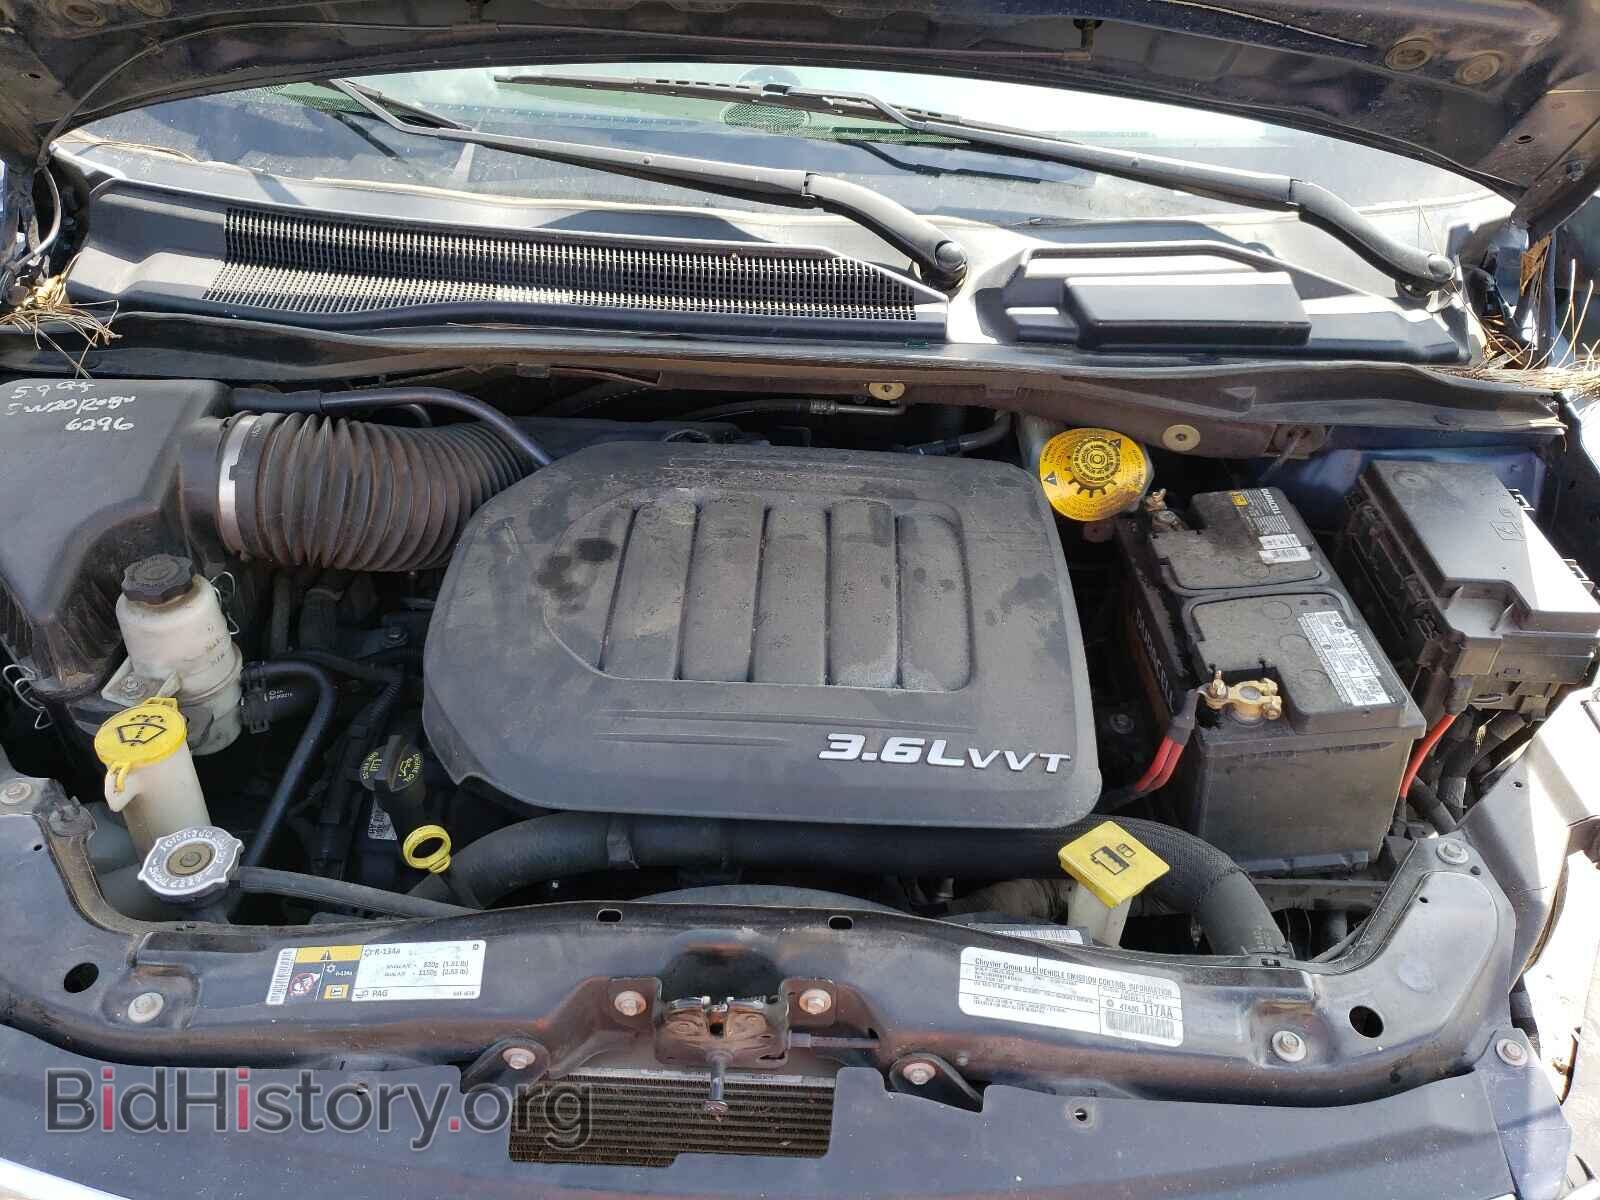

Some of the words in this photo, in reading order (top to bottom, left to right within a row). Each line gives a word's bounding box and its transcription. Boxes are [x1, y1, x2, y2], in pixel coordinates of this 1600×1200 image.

[65, 416, 135, 431] 6296
[818, 732, 965, 768] 3.6L
[967, 747, 1072, 773] VVT
[975, 957, 1001, 969] Chrysler
[1003, 962, 1023, 973] Group
[1024, 965, 1037, 974] LLC
[1039, 968, 1065, 979] VEHICLE
[1066, 972, 1097, 985] EMISSION
[1098, 977, 1126, 991] CONTROL
[1128, 983, 1172, 997] INFORMATION
[372, 989, 388, 998] PAG
